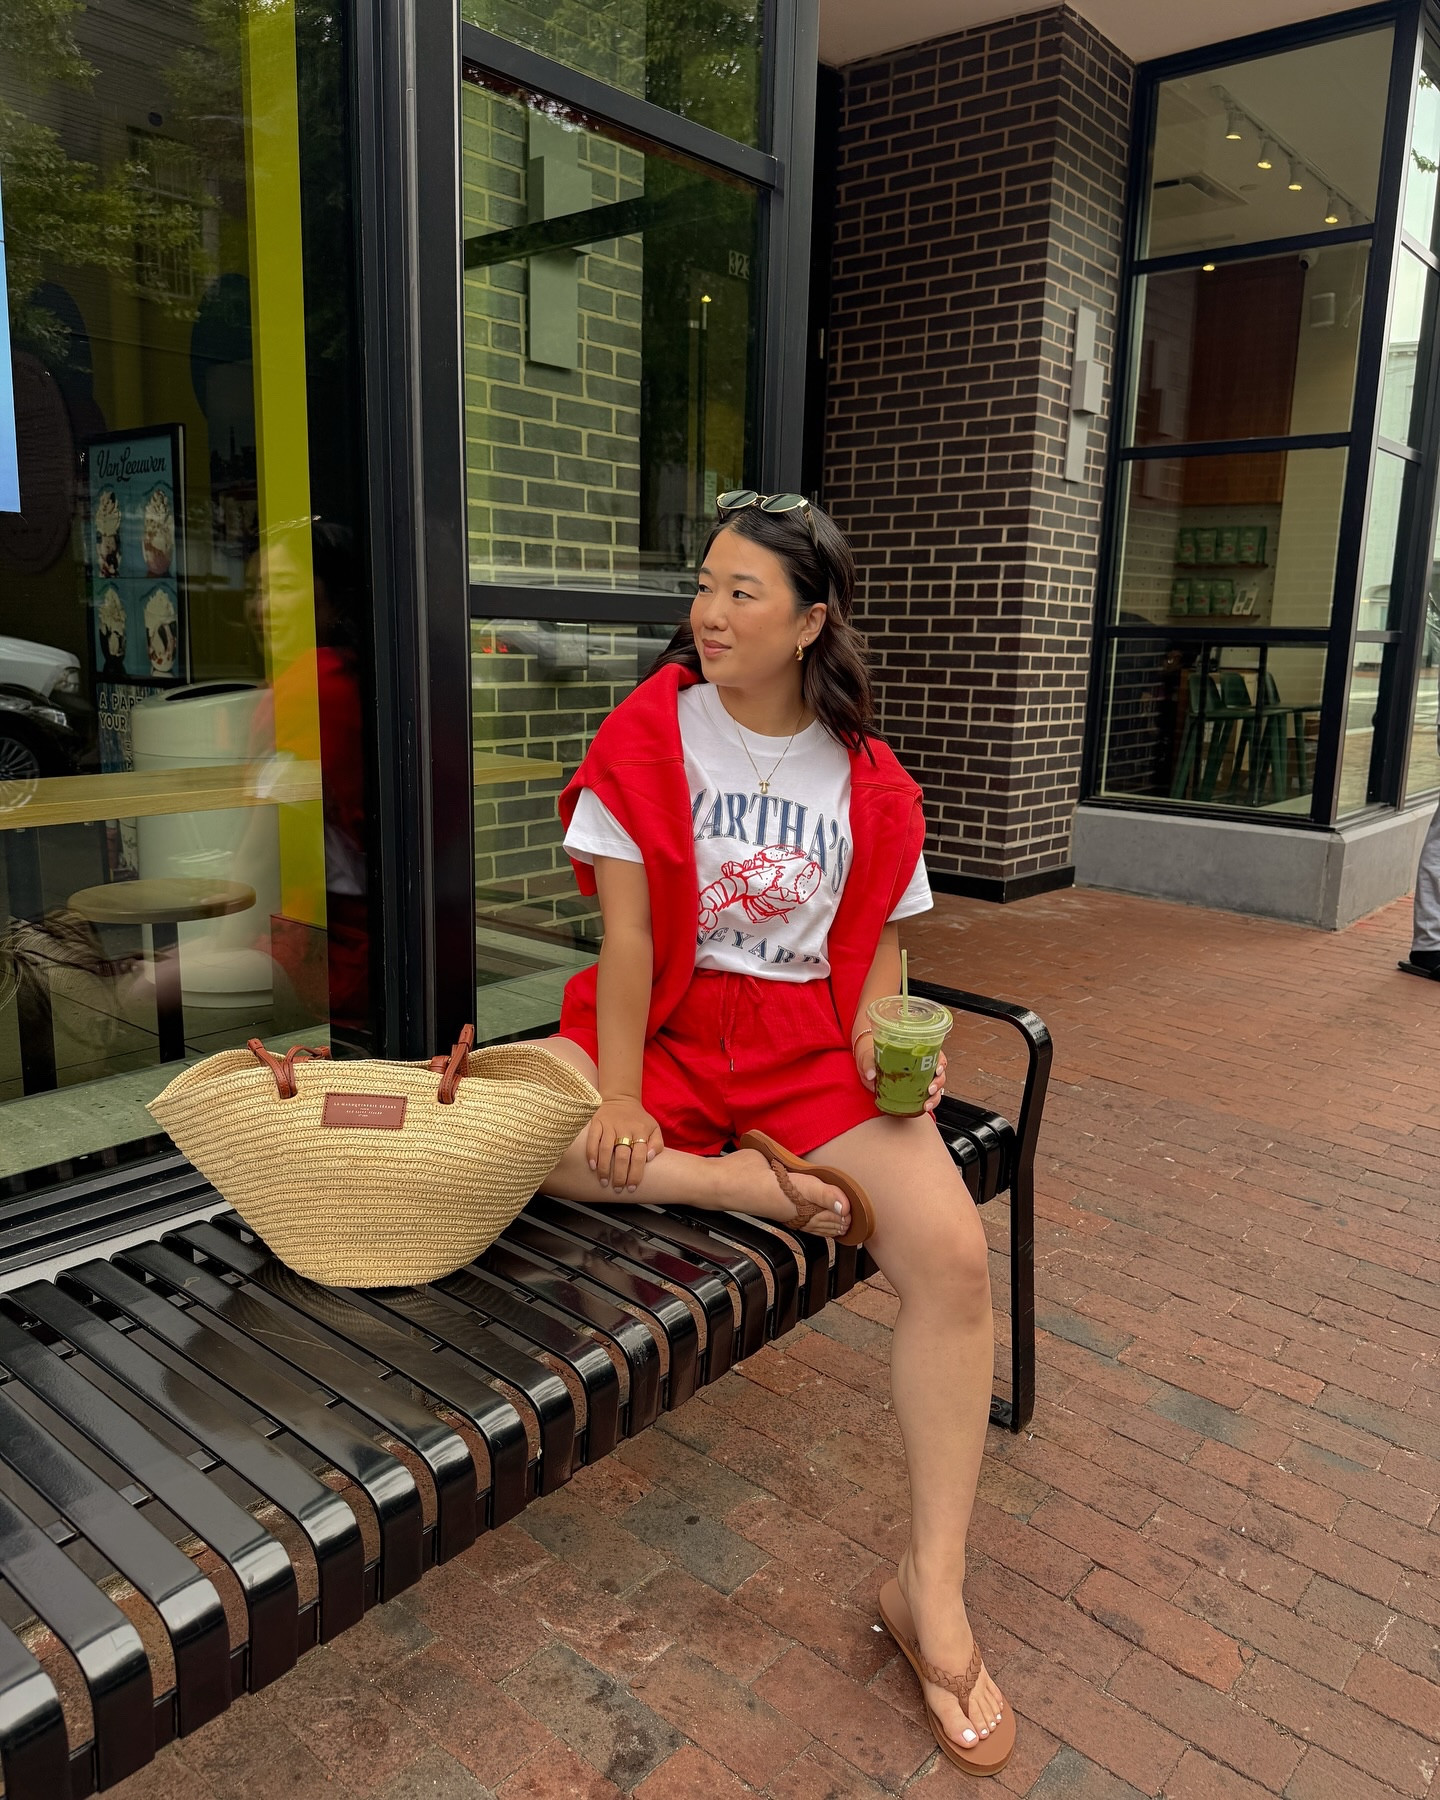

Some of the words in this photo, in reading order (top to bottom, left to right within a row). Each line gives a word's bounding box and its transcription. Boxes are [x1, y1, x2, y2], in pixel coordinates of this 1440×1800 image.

[97, 449, 120, 479] Van
[117, 447, 166, 482] Leeuwen
[99, 692, 108, 709] A
[98, 712, 127, 733] YOUR
